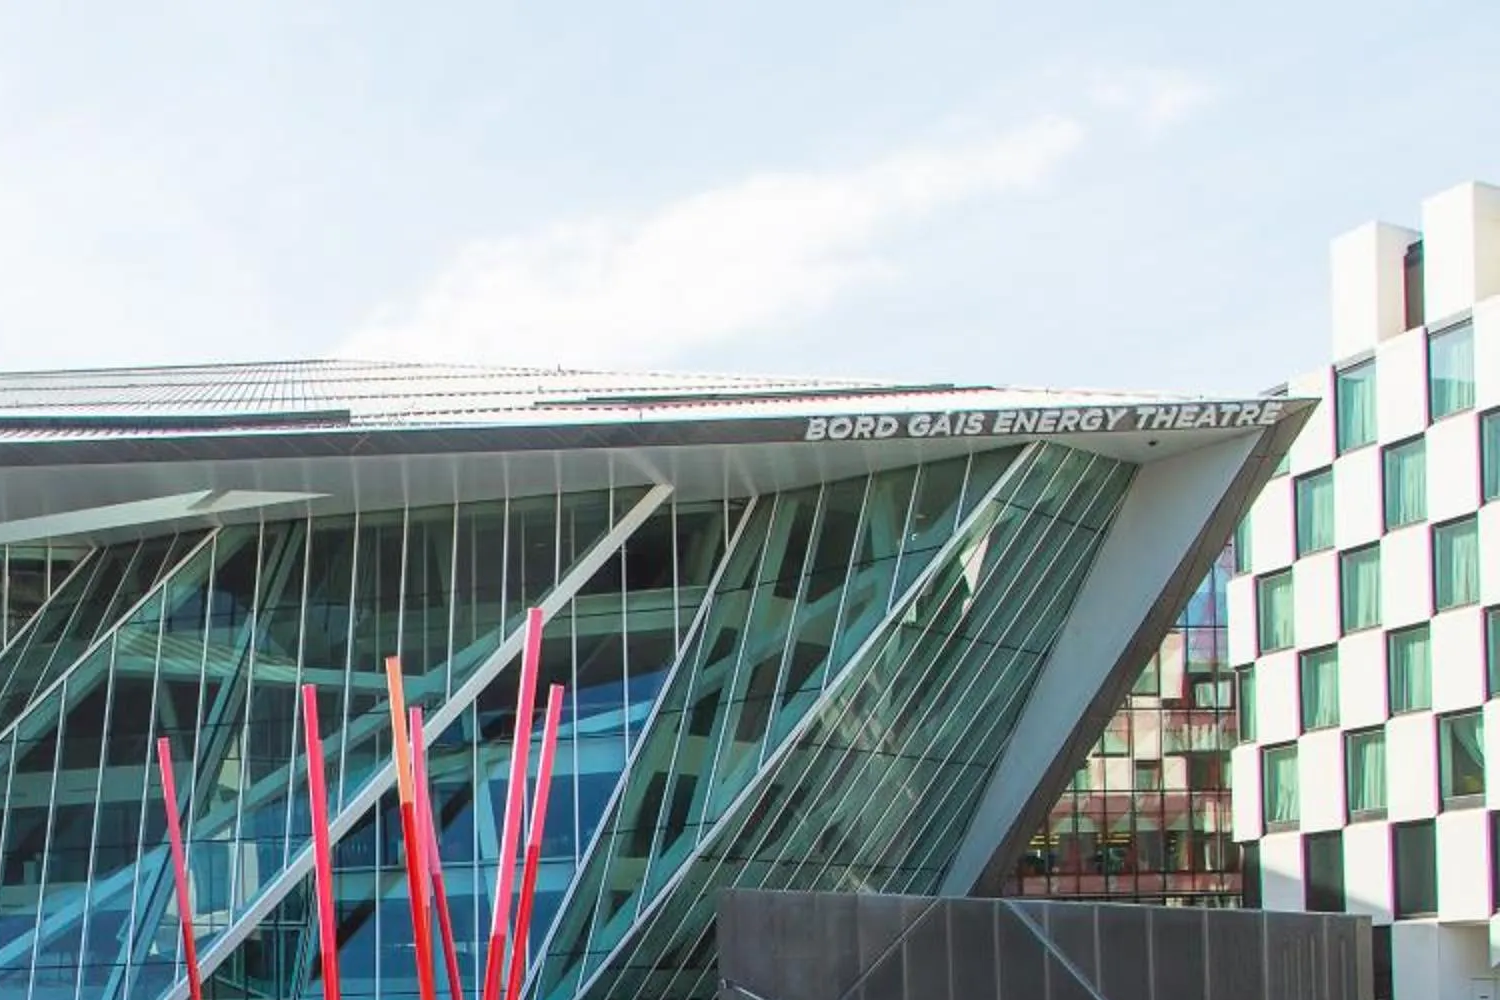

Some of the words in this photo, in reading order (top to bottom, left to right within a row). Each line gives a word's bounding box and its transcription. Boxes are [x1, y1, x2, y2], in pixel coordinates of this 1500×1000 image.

[805, 416, 899, 440] BORD
[992, 407, 1127, 433] ENERGY
[1136, 401, 1283, 429] THEATRE
